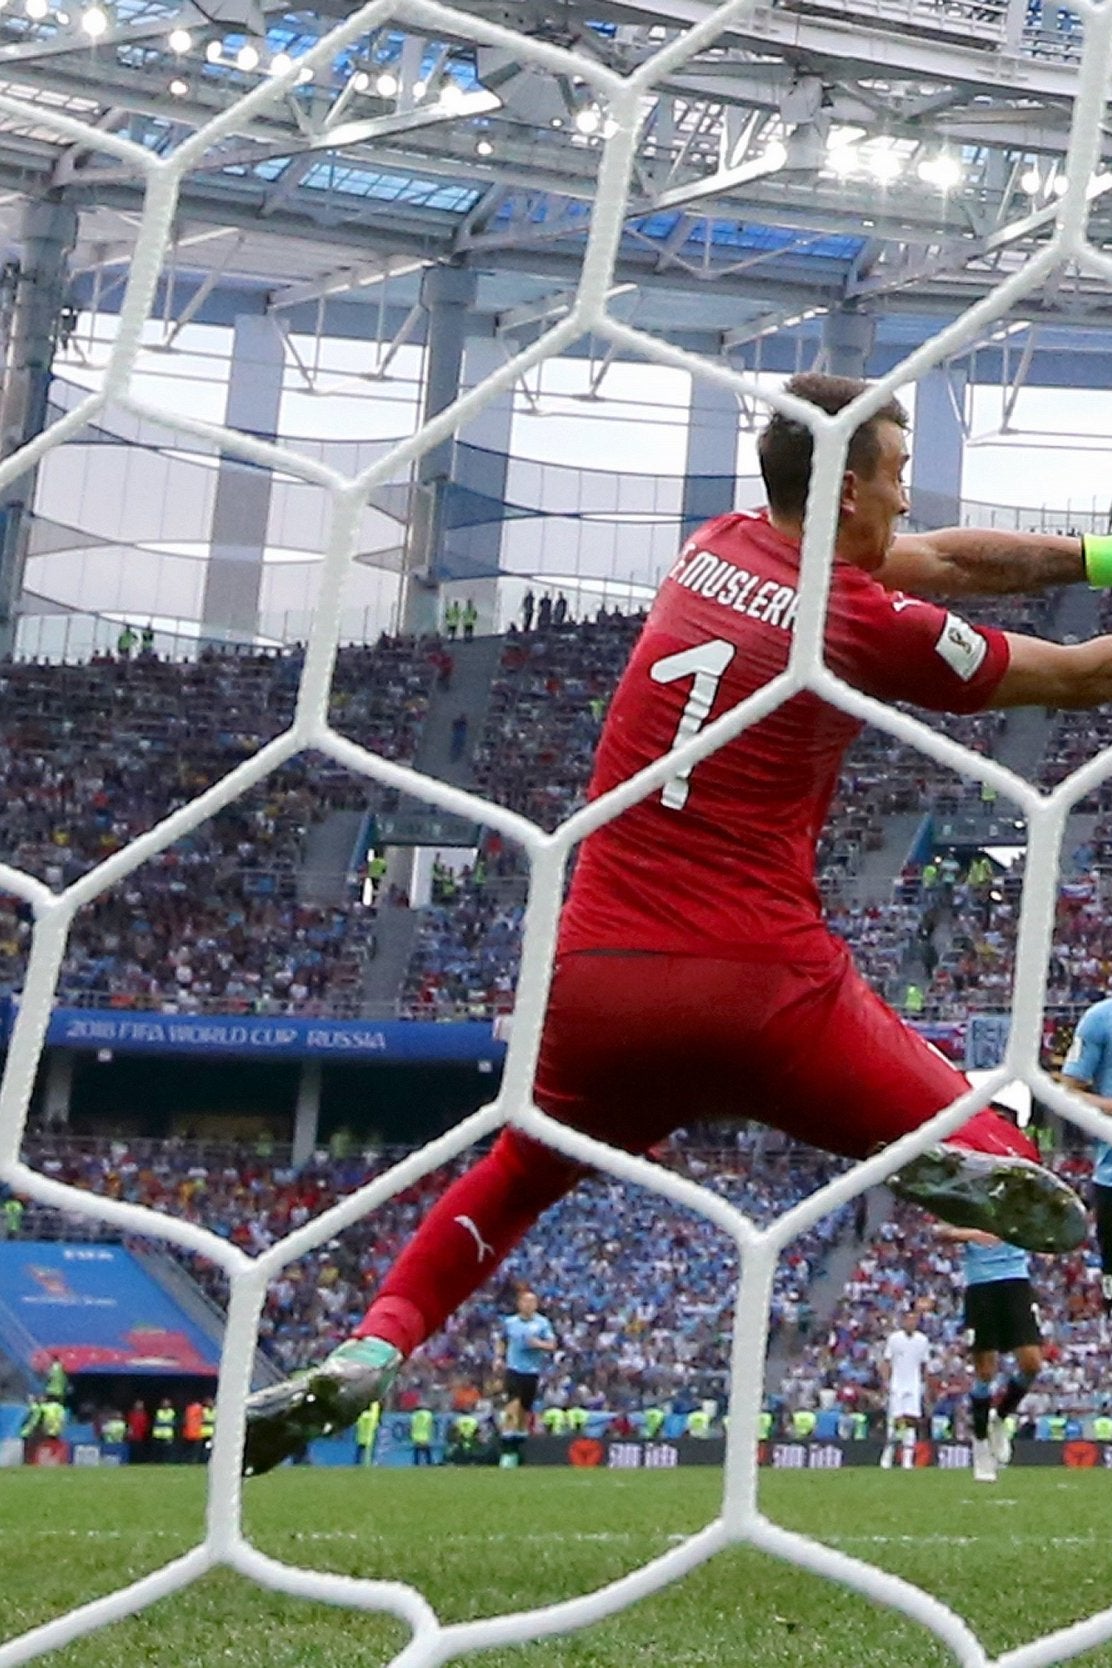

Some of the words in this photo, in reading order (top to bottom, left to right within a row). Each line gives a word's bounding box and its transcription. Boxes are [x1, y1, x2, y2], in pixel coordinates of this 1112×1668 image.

[650, 638, 736, 811] 1
[118, 1021, 165, 1042] FIFA
[168, 1023, 248, 1044] WORLD
[250, 1027, 298, 1046] CUP
[305, 1029, 387, 1050] RUSSIA
